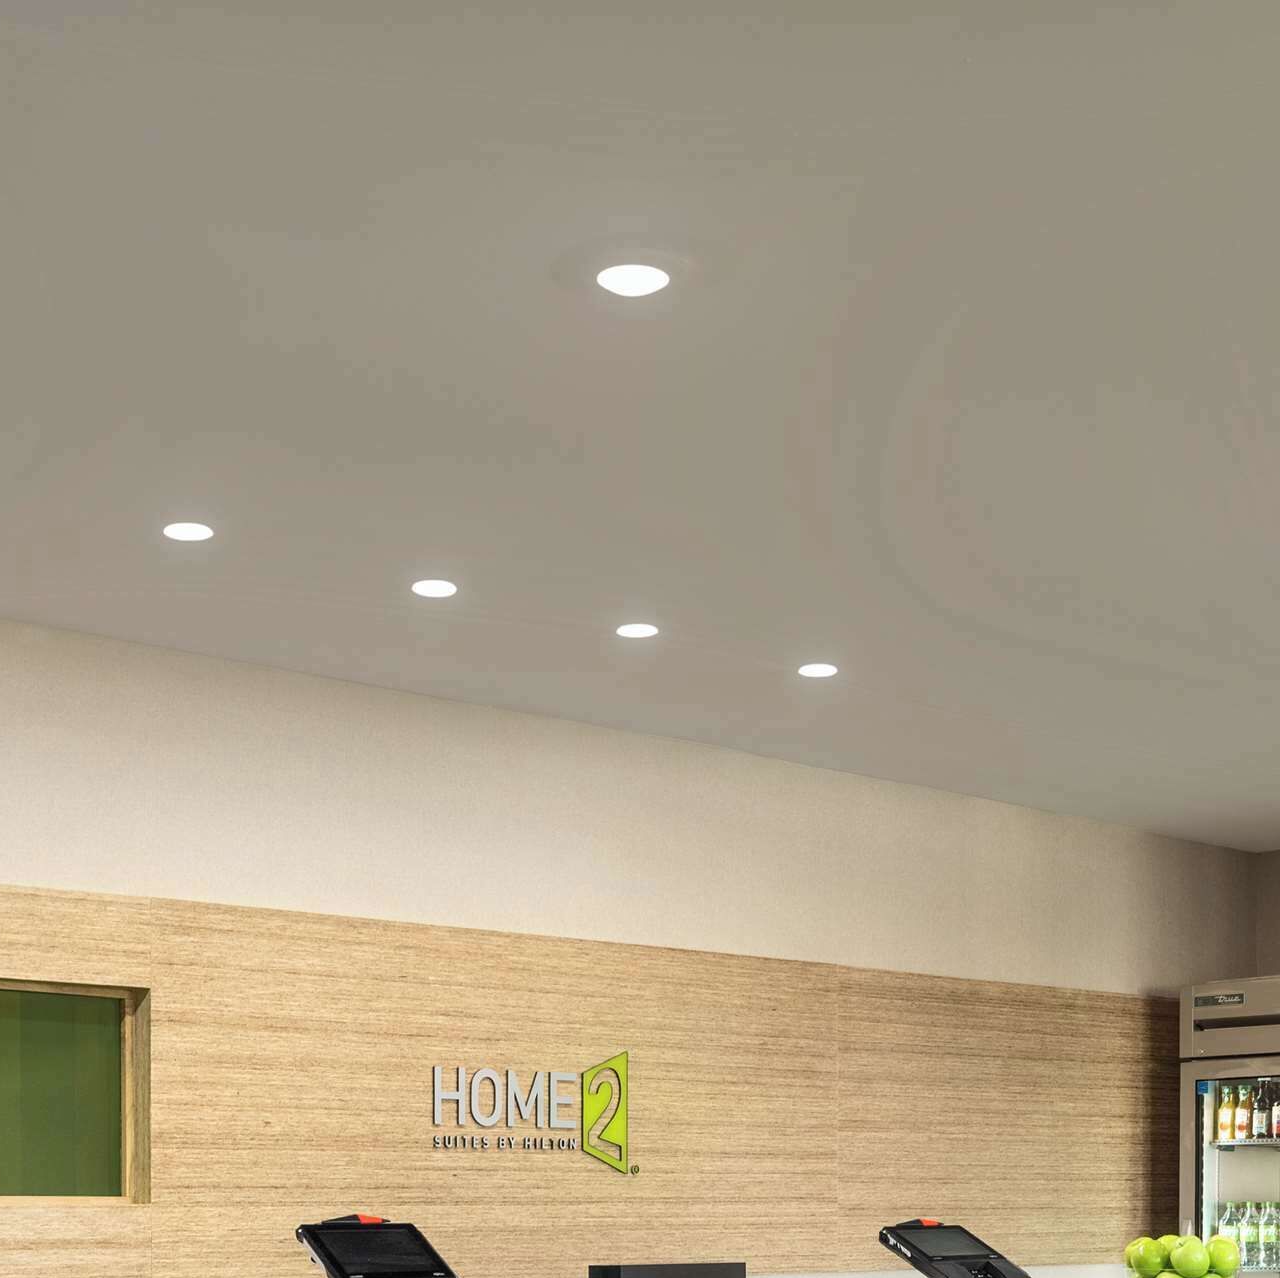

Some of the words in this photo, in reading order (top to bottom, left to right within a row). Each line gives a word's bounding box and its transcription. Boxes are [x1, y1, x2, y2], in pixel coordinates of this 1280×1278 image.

[432, 1066, 578, 1129] HOME
[432, 1135, 491, 1150] SUITES
[498, 1136, 516, 1150] BY
[523, 1137, 578, 1150] HILTON
